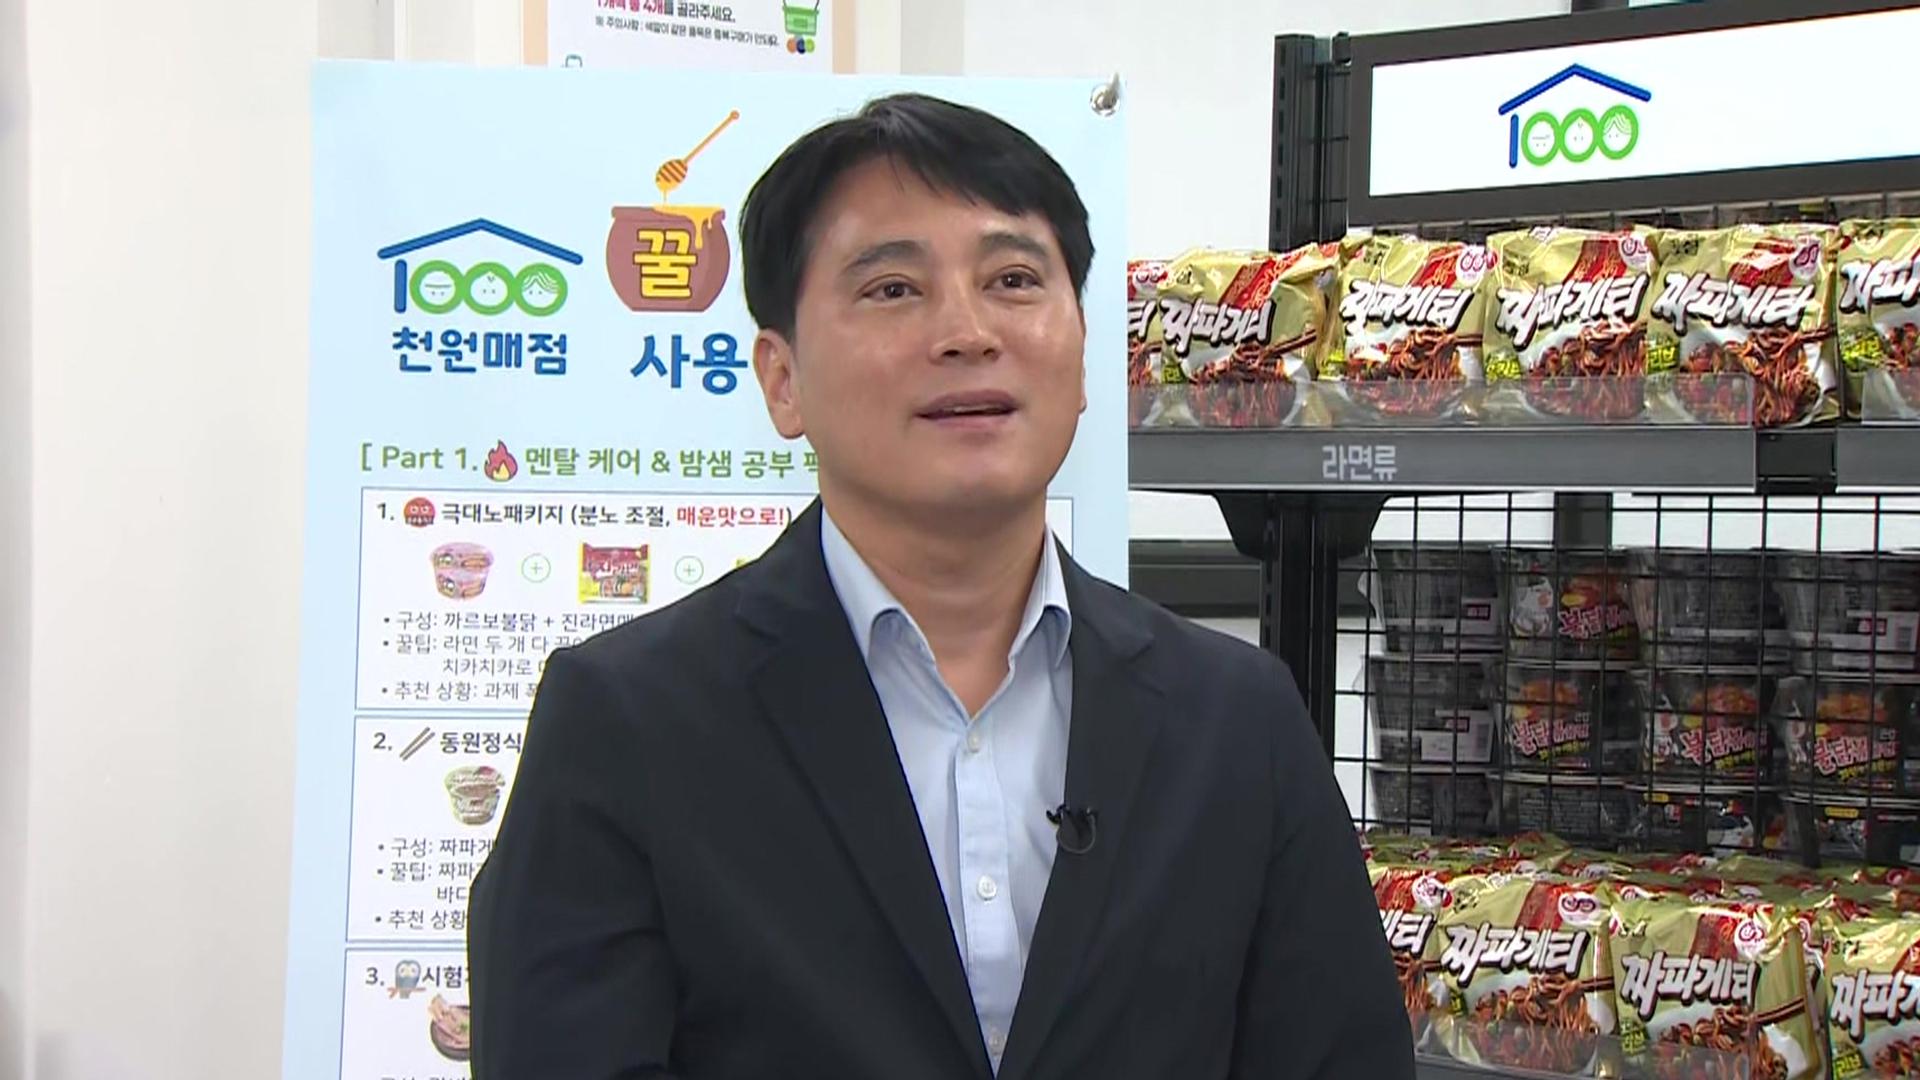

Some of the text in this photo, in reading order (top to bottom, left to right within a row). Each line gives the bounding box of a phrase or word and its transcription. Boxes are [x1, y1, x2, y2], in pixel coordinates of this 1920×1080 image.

[677, 3, 736, 22] 골라주세요.
[633, 229, 698, 300] 꿀
[1340, 279, 1475, 336] 짜파게티
[1496, 273, 1649, 350] 짜파게티
[1651, 272, 1815, 337] 짜파게티
[392, 326, 567, 375] 천원매점
[630, 332, 748, 395] 사용
[382, 445, 444, 470] Part
[455, 447, 478, 471] 1.
[525, 447, 579, 476] 멘탈
[588, 448, 641, 476] 케어
[651, 450, 670, 473] &
[680, 450, 731, 478] 밤샘
[741, 451, 795, 479] 공부
[1322, 444, 1398, 482] 라면류
[376, 502, 793, 528] 1. 극대노패키지 (분노 조절, 매운맛으로!)
[395, 611, 438, 632] 구성:
[443, 612, 538, 633] 까르보불닭
[395, 634, 438, 654] 꿀팁:
[443, 634, 479, 654] 라면
[485, 635, 503, 654] 두
[508, 635, 526, 654] 개
[442, 658, 534, 677] 치카치카로
[394, 682, 430, 701] 추천
[436, 682, 478, 701] 상황:
[484, 682, 519, 701] 과제
[373, 731, 522, 754] 2. 동원정식
[391, 838, 433, 858] 구성:
[390, 862, 481, 882] 꿀팁: 짜파
[388, 909, 425, 930] 추천
[1440, 921, 1591, 988] 짜파게티
[365, 965, 469, 989] 3. 시험
[1620, 951, 1761, 1022] 짜파게티
